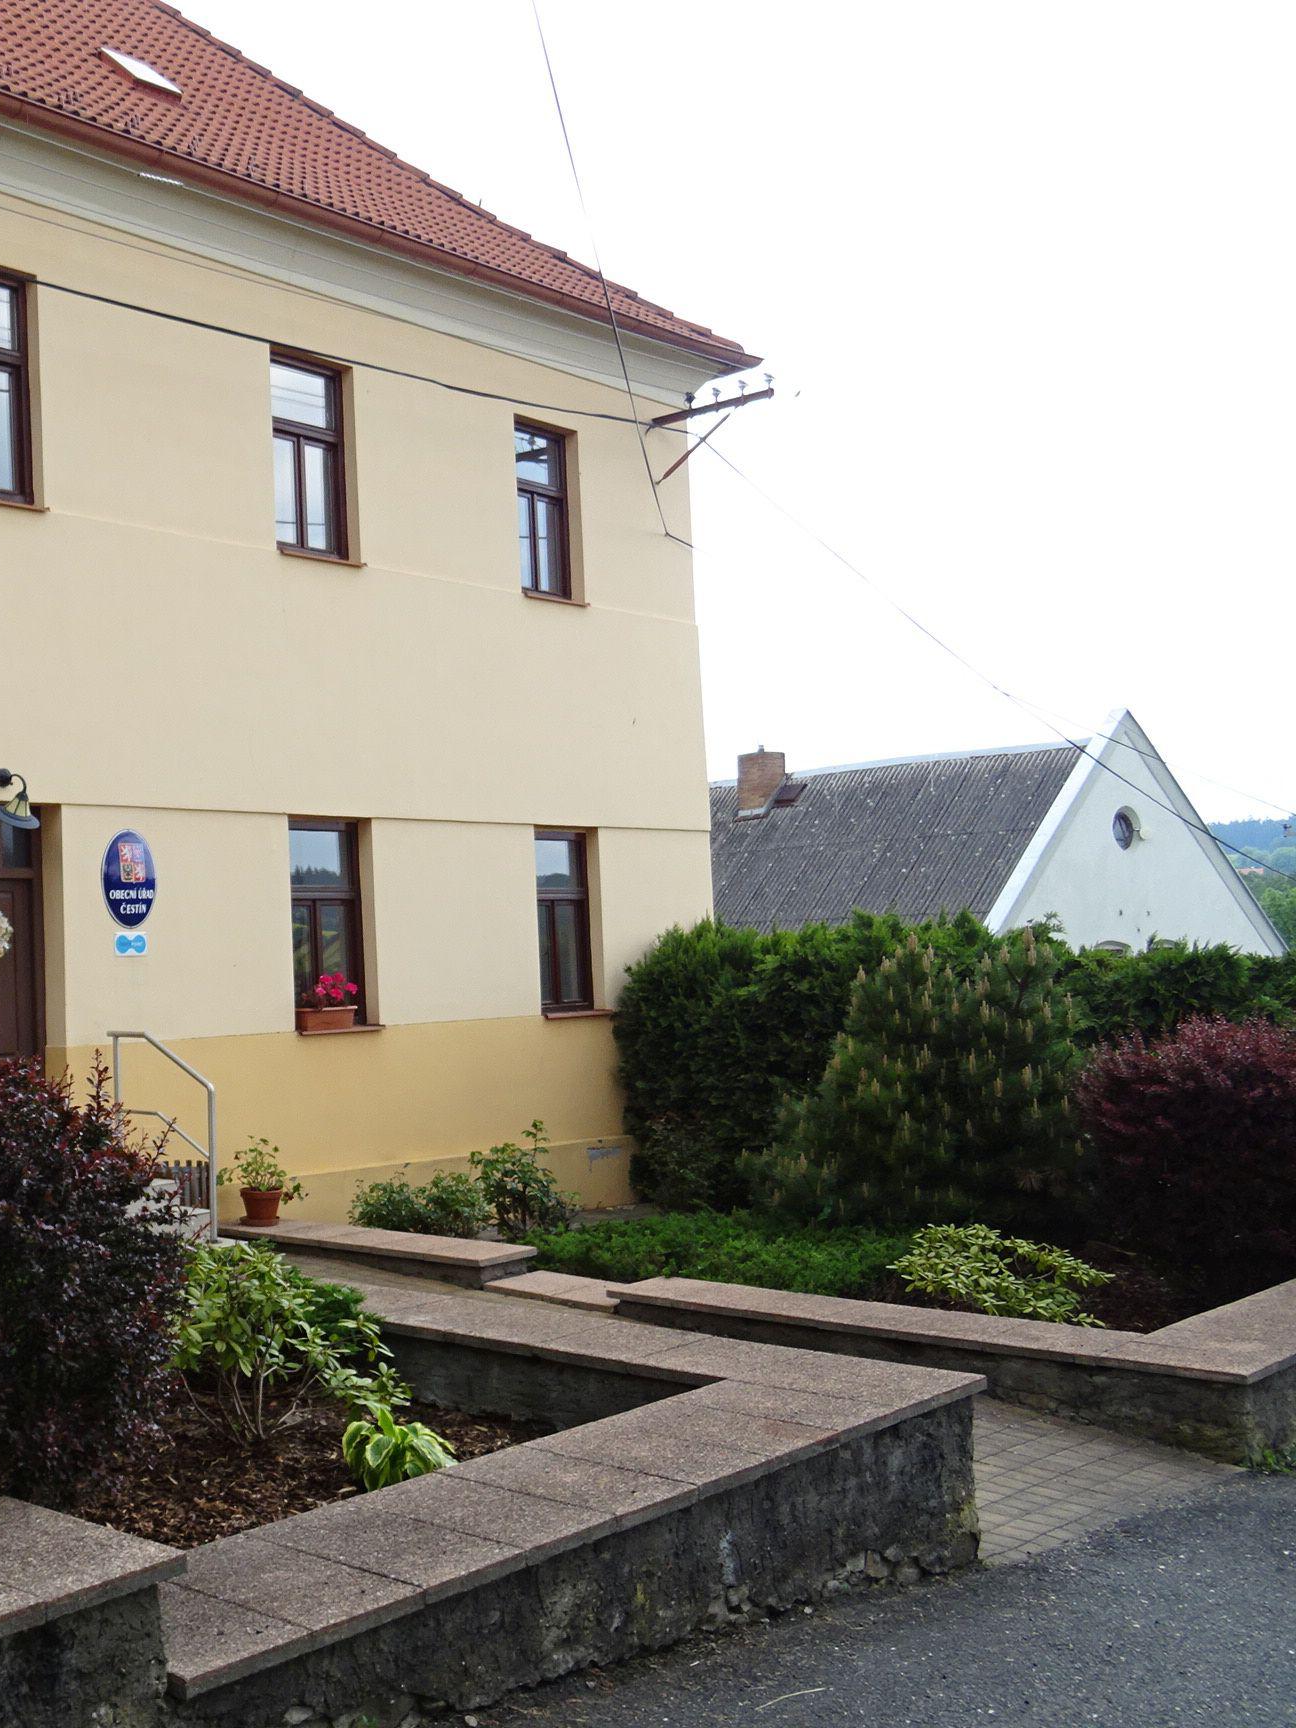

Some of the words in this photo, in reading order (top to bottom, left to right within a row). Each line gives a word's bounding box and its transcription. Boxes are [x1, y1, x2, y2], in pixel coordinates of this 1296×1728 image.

[109, 887, 137, 900] OBECNÍ
[138, 887, 154, 900] ÚŘAD
[120, 902, 147, 914] ČESTÍN
